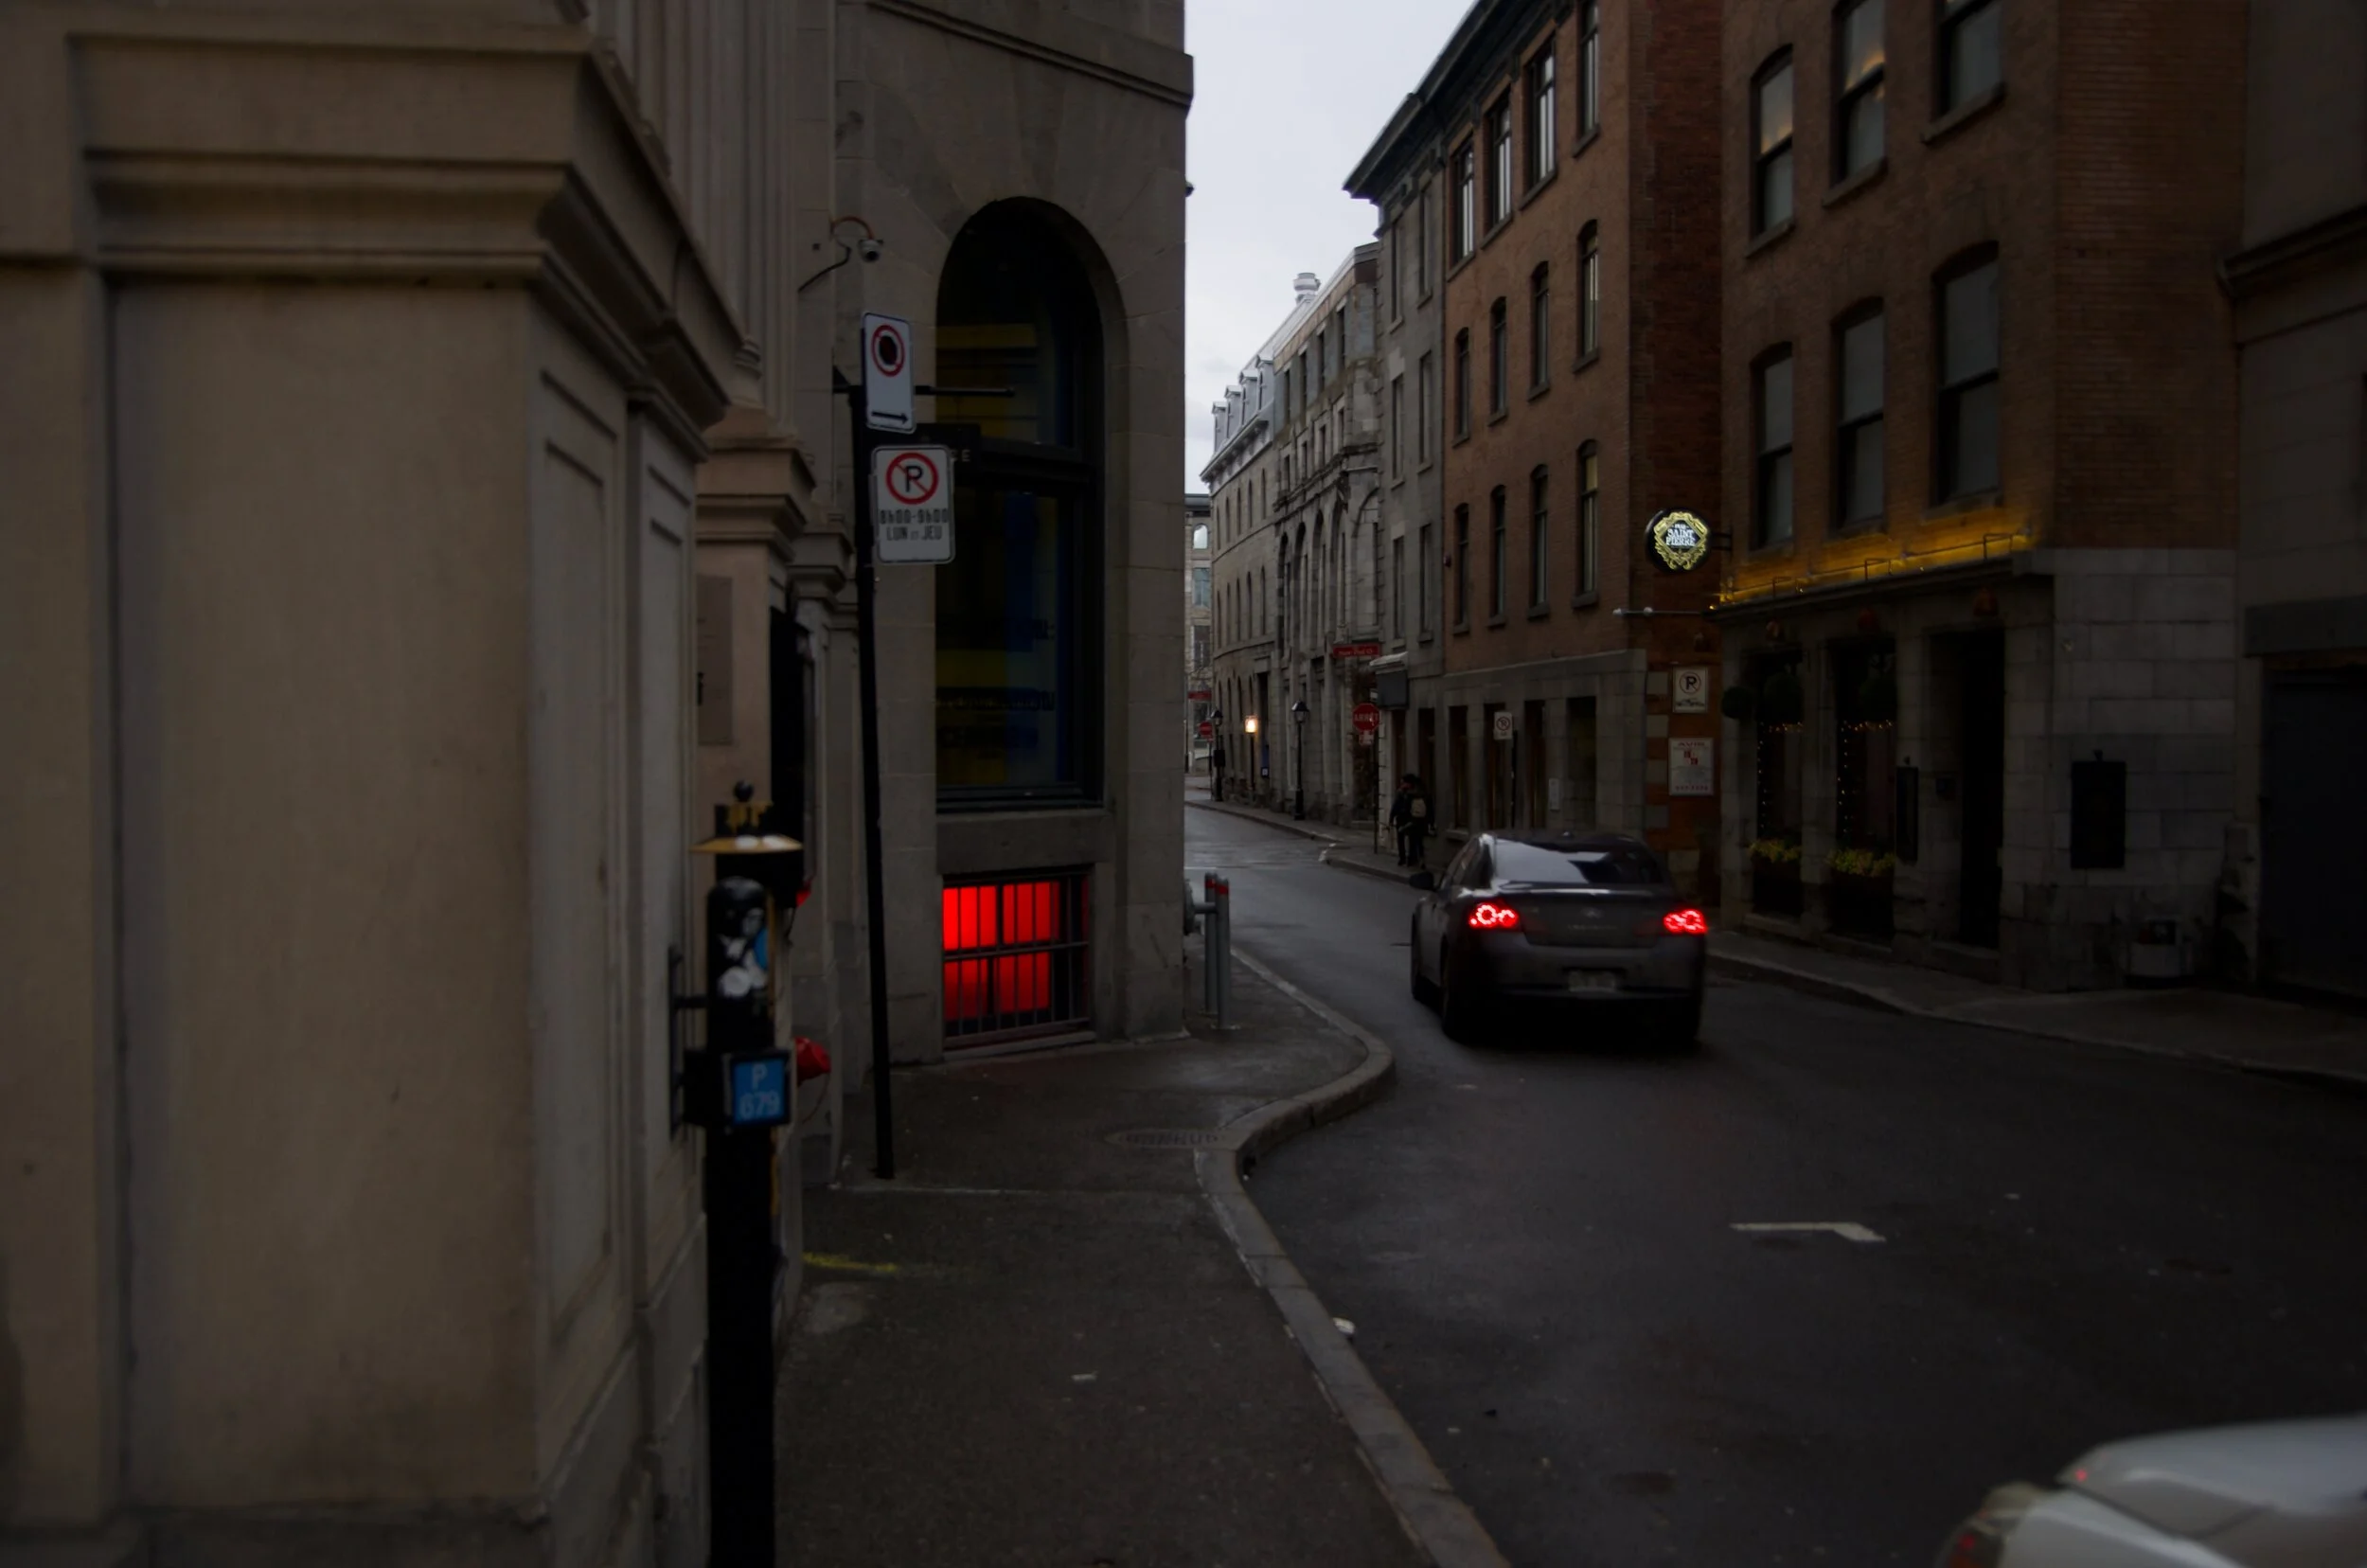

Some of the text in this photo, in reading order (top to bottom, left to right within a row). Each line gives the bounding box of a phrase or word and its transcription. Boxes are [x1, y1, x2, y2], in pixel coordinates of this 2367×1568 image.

[886, 526, 908, 541] LUN
[921, 526, 942, 540] JEU
[1667, 528, 1695, 538] SAINT
[1665, 536, 1696, 546] PIERRE
[752, 1062, 768, 1090] P
